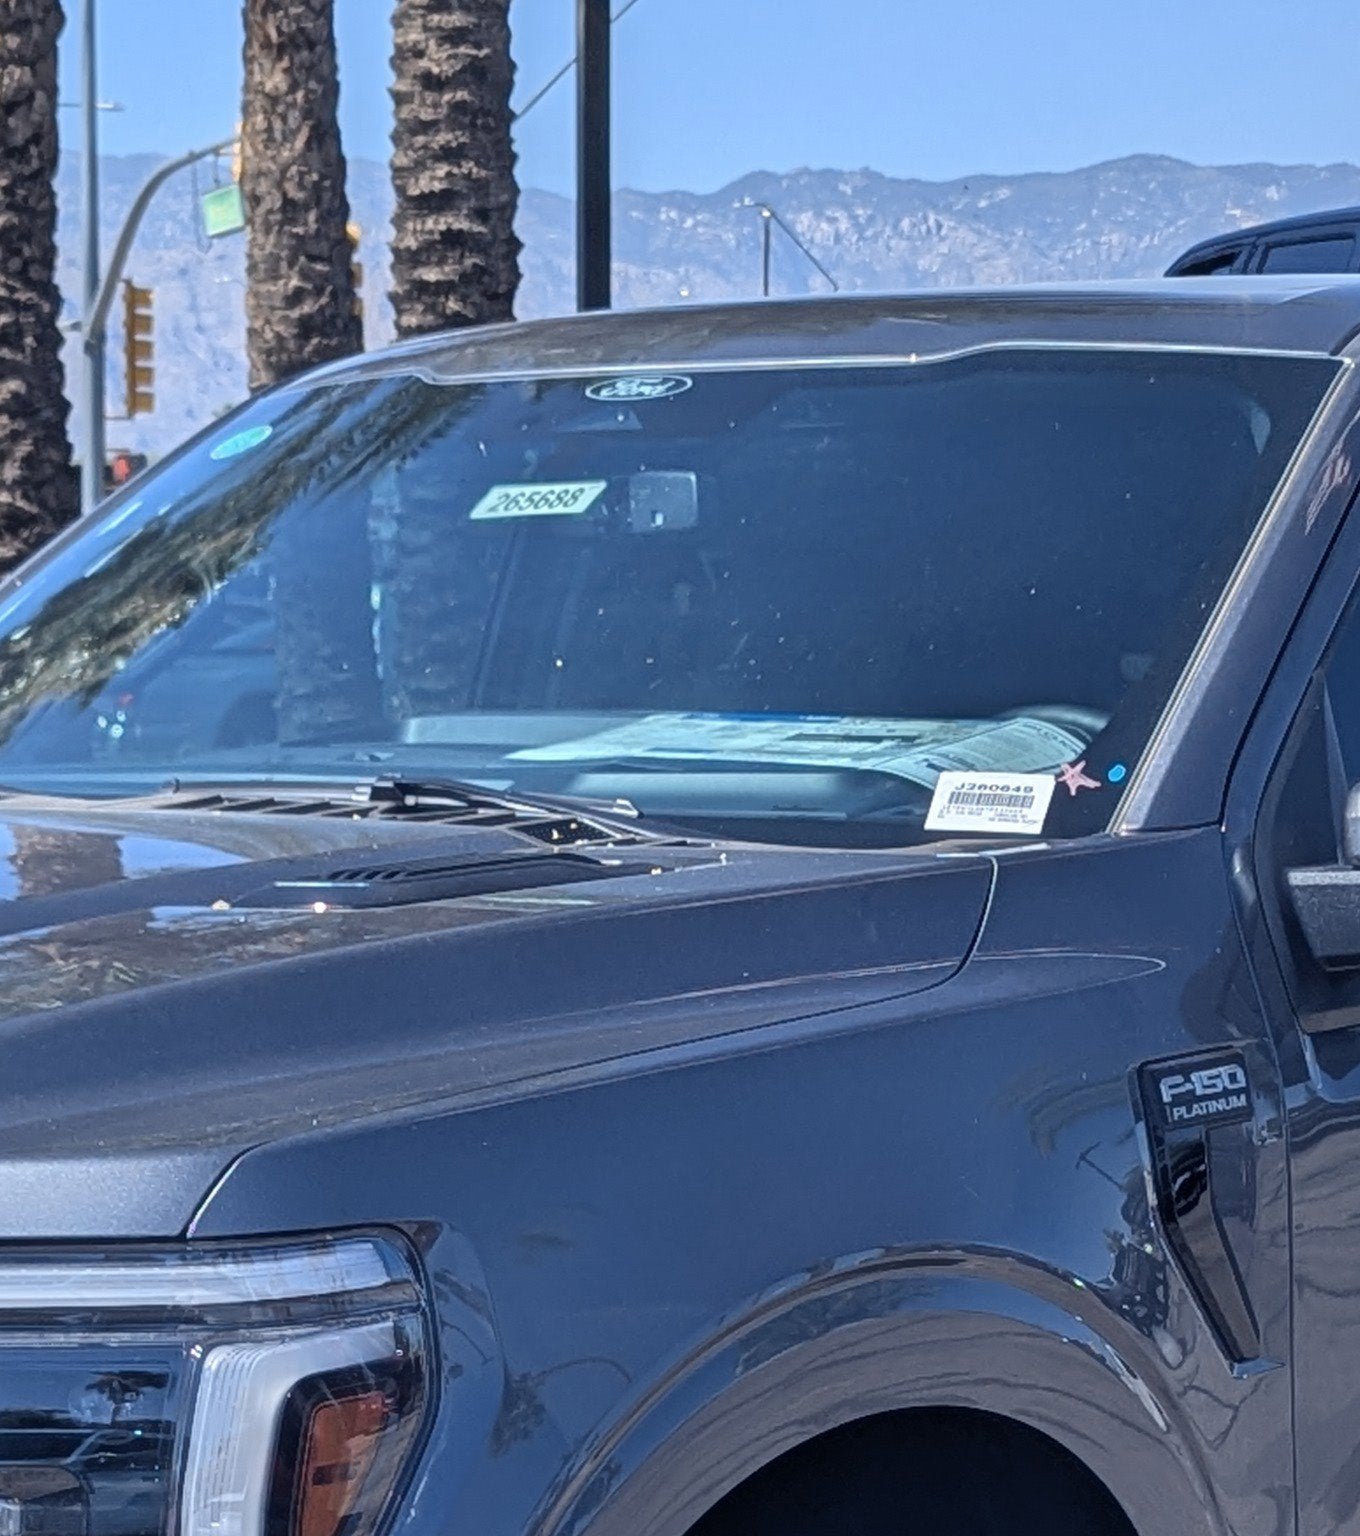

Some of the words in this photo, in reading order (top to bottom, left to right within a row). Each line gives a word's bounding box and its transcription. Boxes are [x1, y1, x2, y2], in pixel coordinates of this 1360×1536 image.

[489, 487, 586, 513] 265688
[1160, 1064, 1247, 1103] F-150
[1173, 1093, 1248, 1121] PLATINUM
